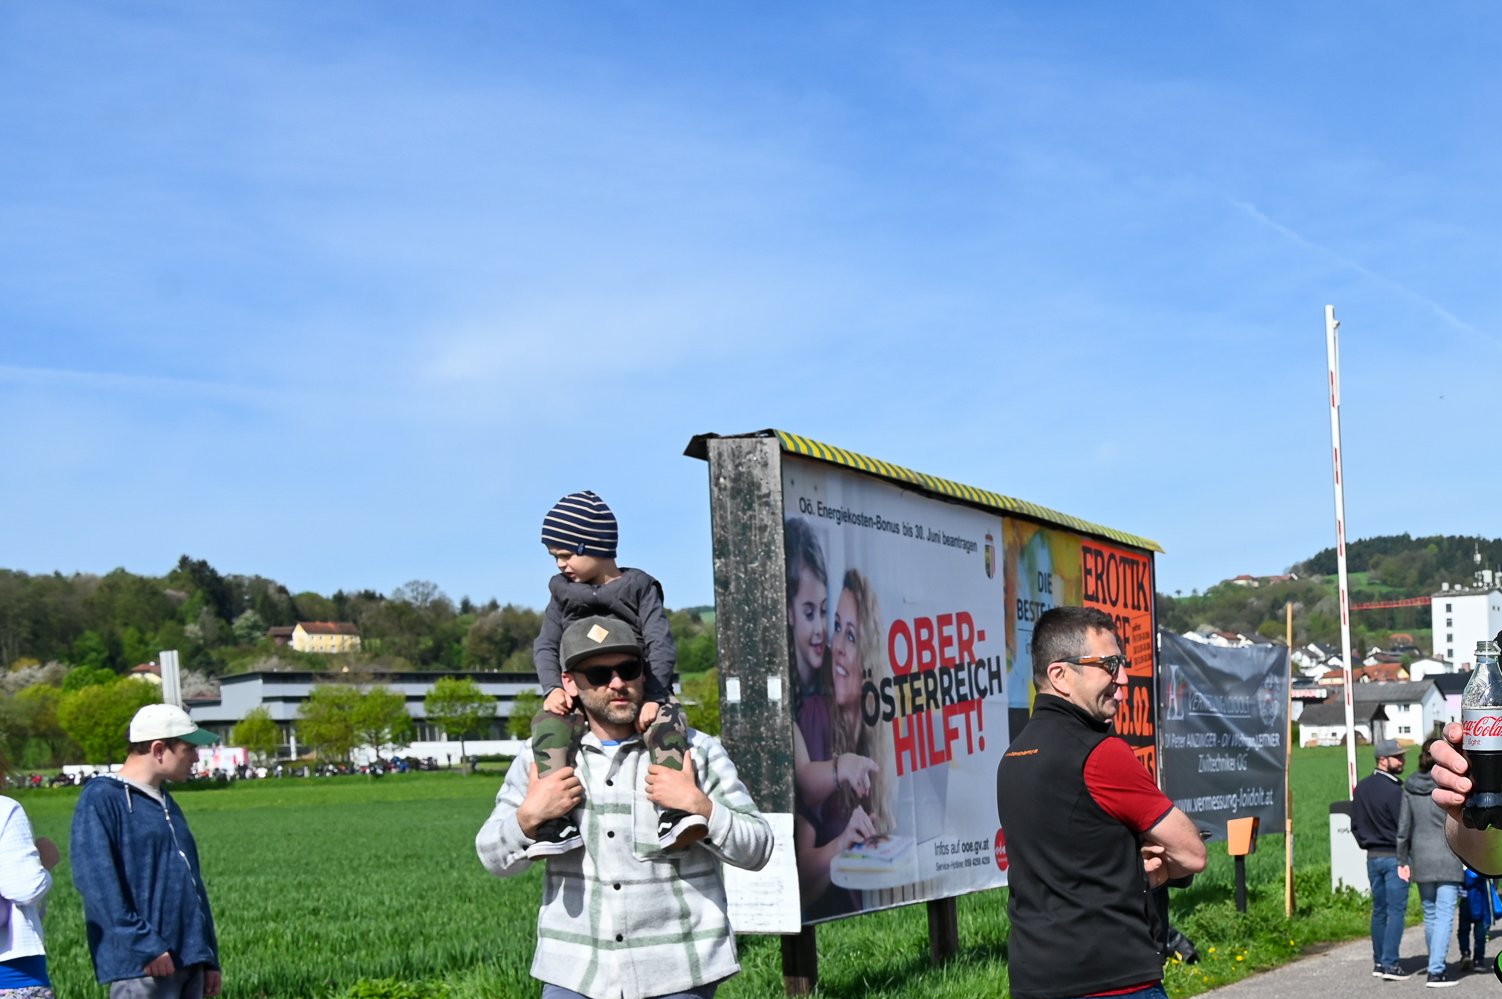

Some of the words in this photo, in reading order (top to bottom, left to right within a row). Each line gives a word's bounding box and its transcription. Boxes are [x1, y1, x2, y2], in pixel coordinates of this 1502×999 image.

[817, 501, 900, 535] Energiekosten-Bonus
[902, 522, 913, 537] bis
[915, 525, 925, 540] 30.
[926, 527, 941, 544] Juni
[942, 531, 978, 554] beantragen
[1037, 571, 1052, 594] DIE
[1082, 546, 1149, 612] EROTIK
[888, 611, 986, 677] OBER-
[861, 655, 1003, 727] ÖSTERREICH
[892, 697, 986, 777] HILFT!
[1468, 737, 1482, 747] light
[934, 841, 950, 856] Infos
[951, 839, 960, 854] auf
[961, 838, 990, 855] ooe.gv.at
